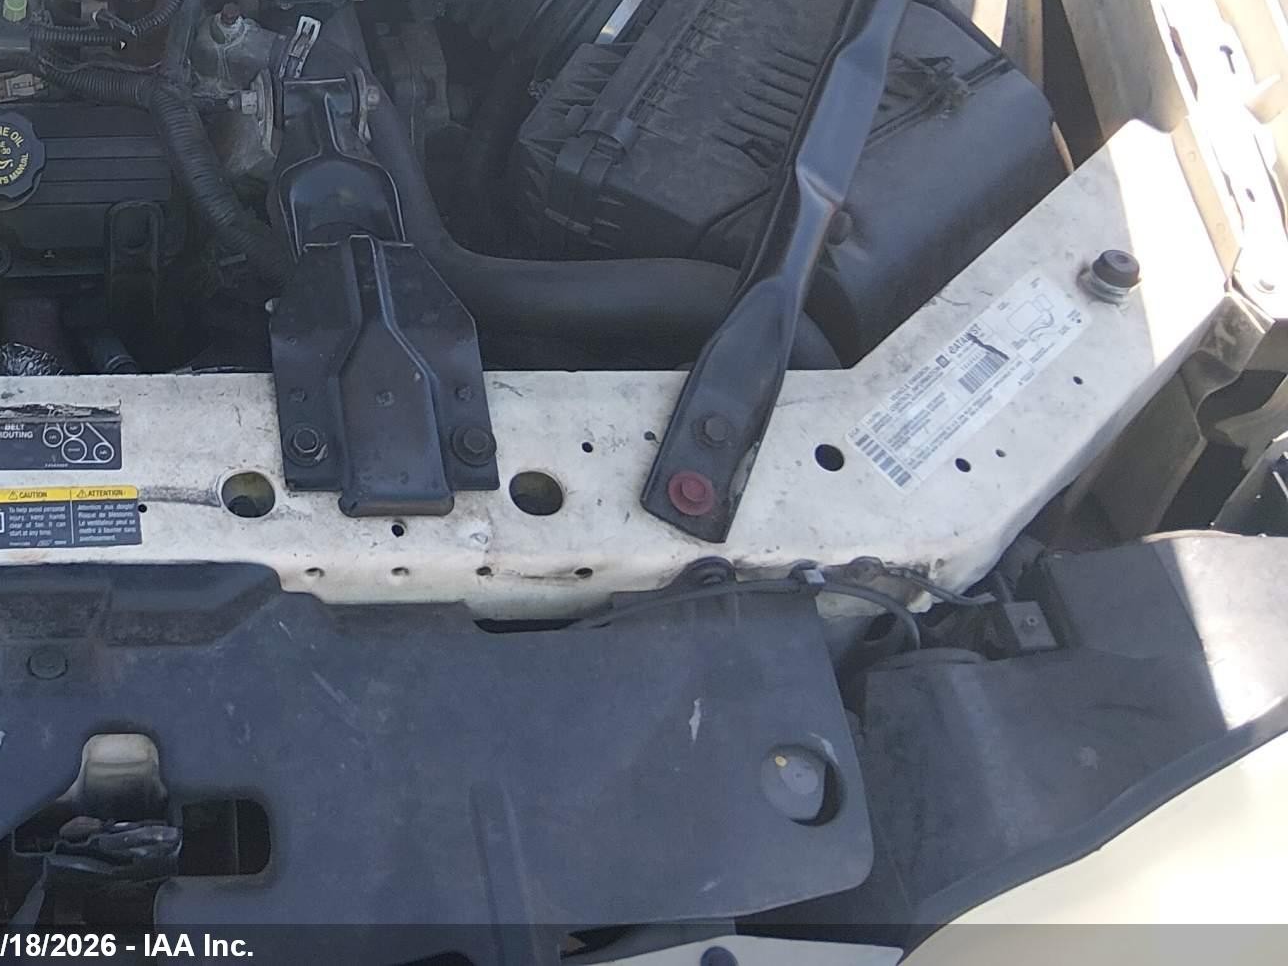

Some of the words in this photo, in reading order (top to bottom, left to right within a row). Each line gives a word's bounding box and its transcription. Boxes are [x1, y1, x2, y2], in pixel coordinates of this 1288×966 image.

[10, 131, 25, 148] OIL
[9, 152, 29, 181] MANUAL
[948, 323, 982, 354] CATAST
[19, 490, 48, 498] CAUTION
